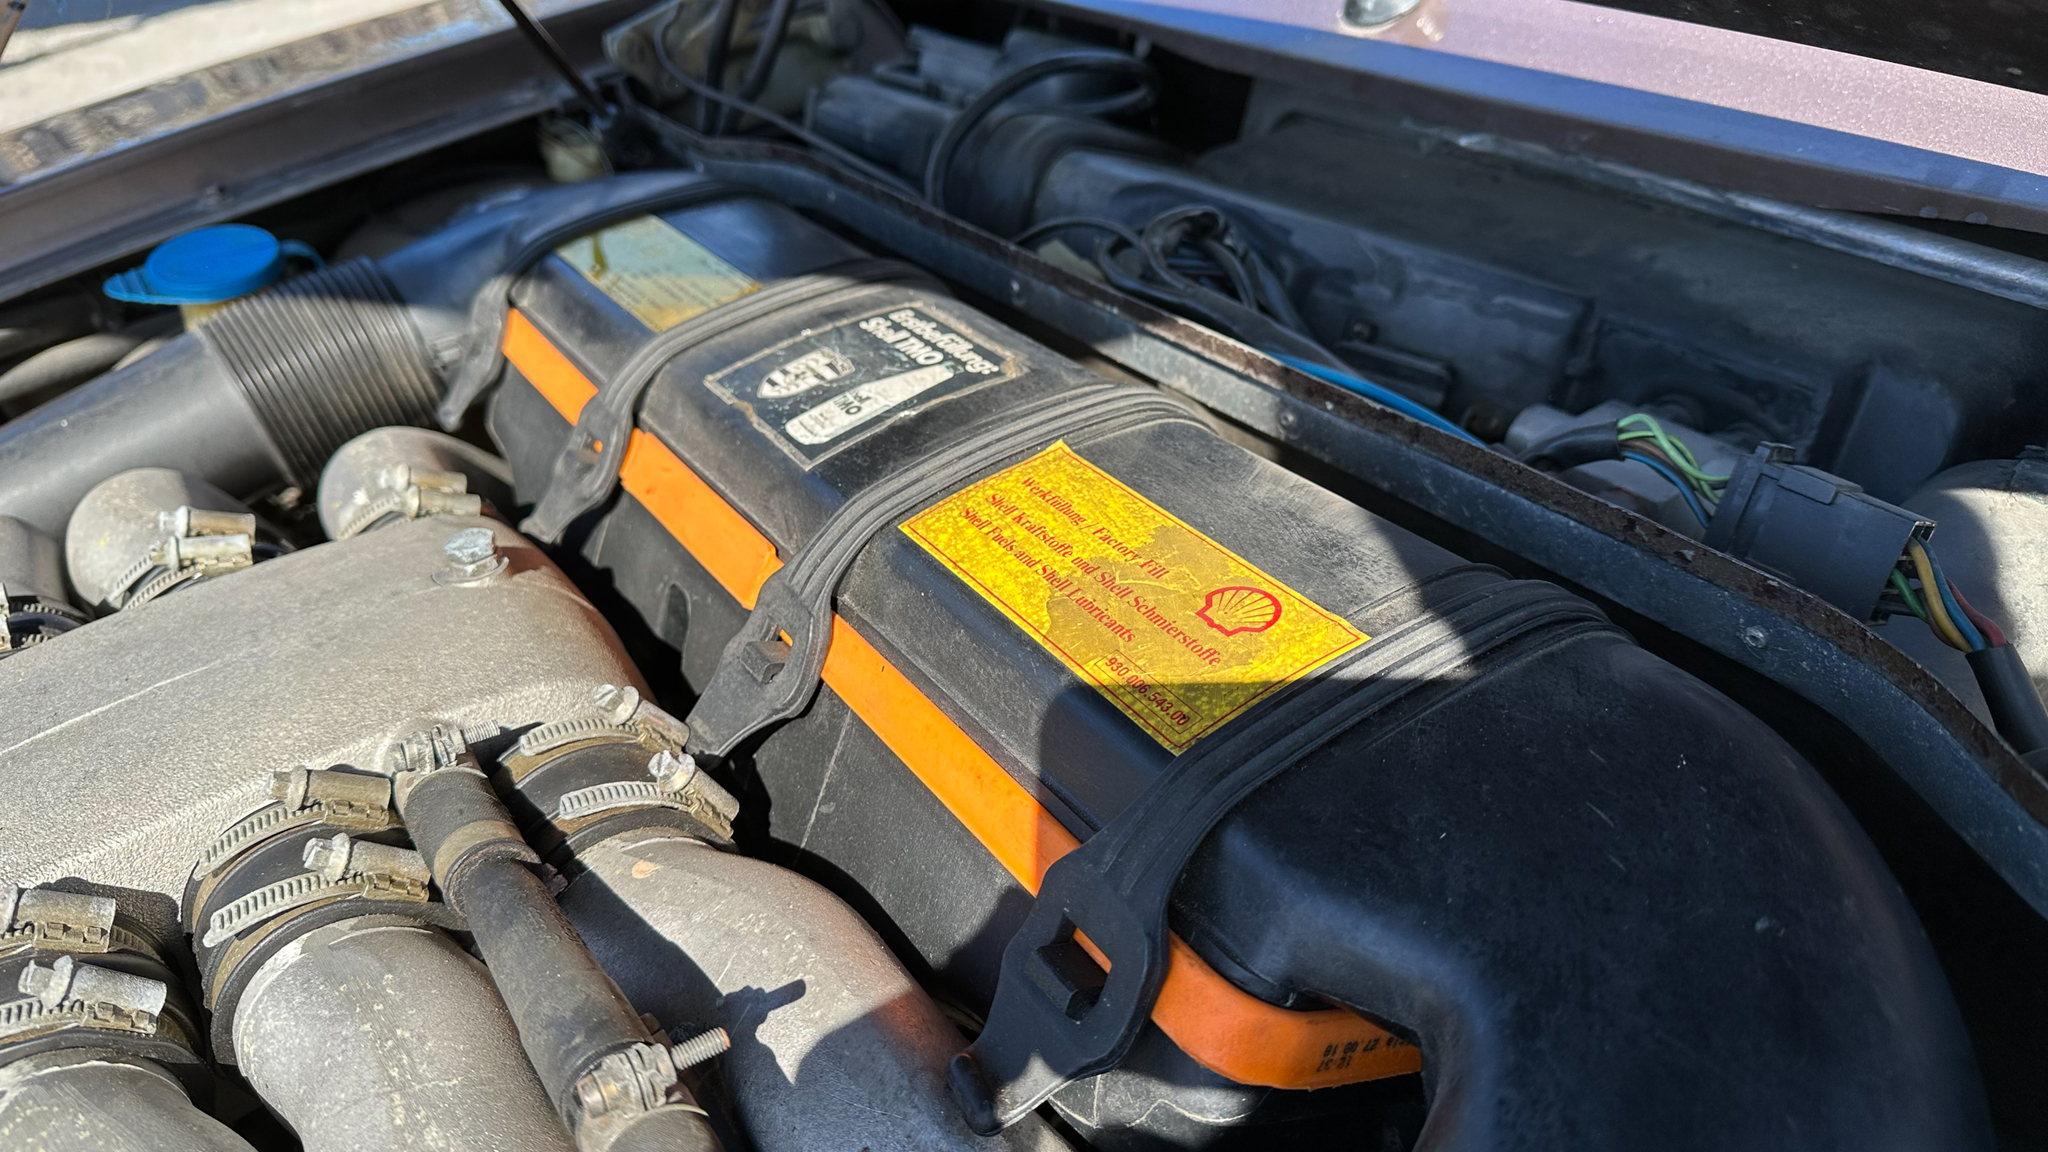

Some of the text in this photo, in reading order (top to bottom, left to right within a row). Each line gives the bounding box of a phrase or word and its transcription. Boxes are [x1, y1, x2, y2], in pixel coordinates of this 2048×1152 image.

[859, 317, 944, 365] Shell TMO
[960, 507, 1136, 643] Shell Fuels and Shell Lubricants
[988, 493, 1221, 666] Shell Kraftstoffe und Shell Schmierstoffe
[1021, 477, 1087, 526] Werkfüllung
[1092, 527, 1142, 562] Factory
[1137, 559, 1169, 580] Fill
[1104, 657, 1191, 726] 930.006.543.00
